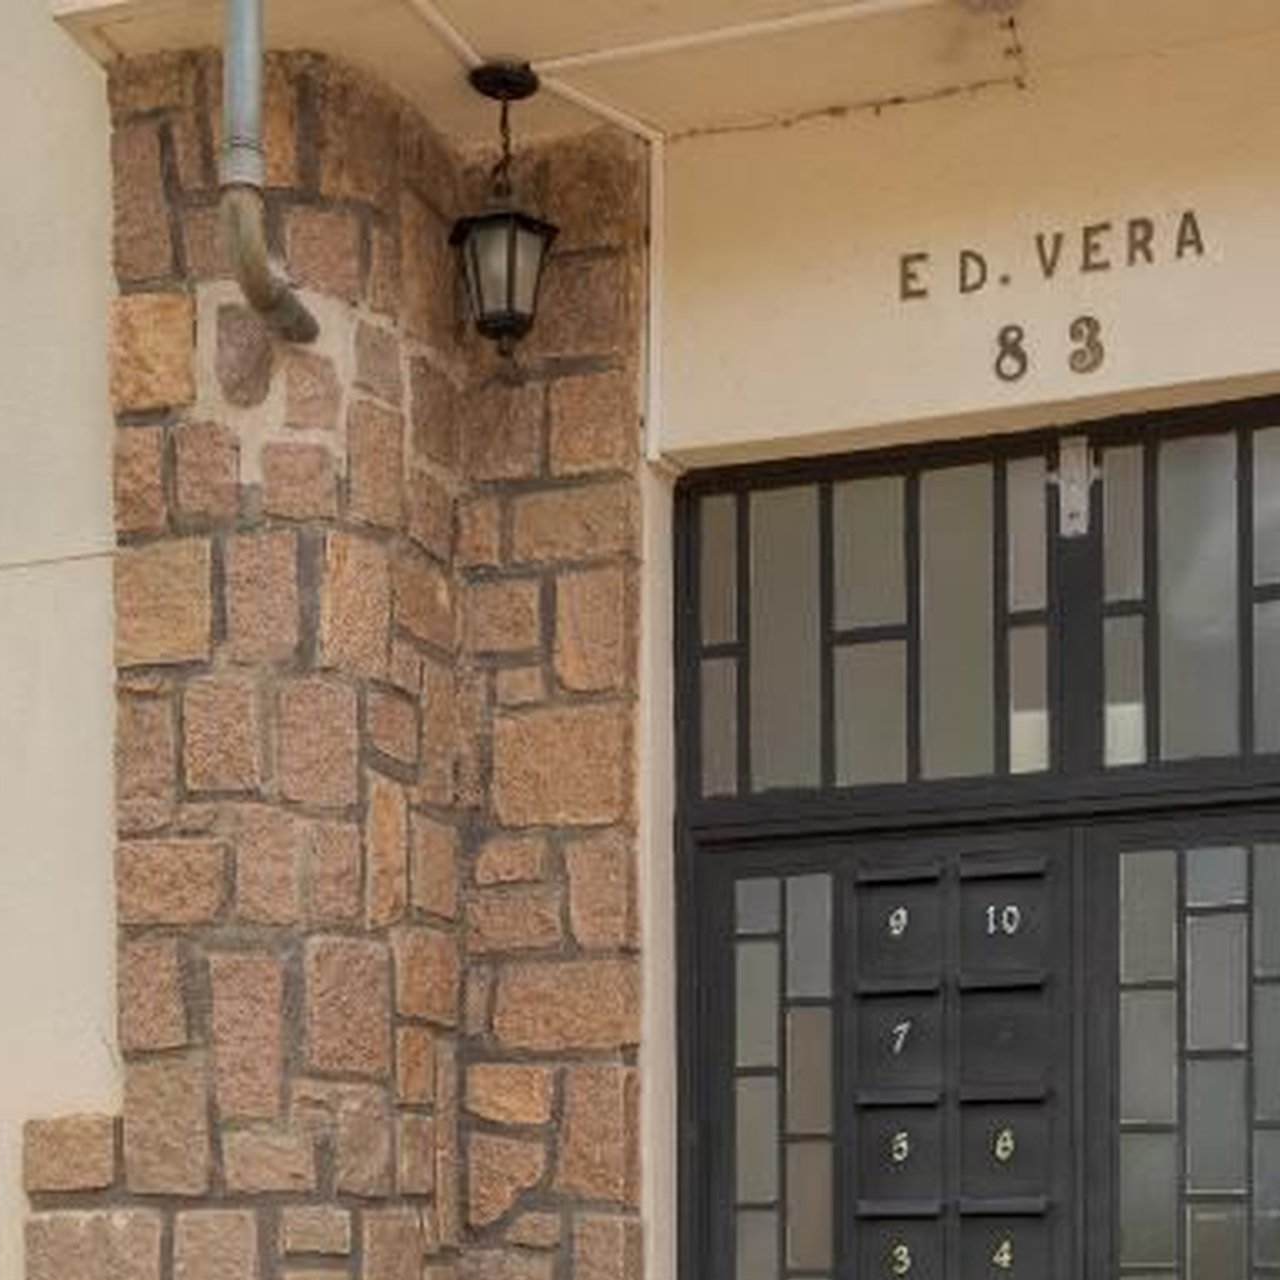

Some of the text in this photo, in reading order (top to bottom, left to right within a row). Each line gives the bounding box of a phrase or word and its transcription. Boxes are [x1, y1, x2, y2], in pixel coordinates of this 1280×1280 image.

[900, 211, 1205, 300] ED. VERA
[995, 316, 1105, 382] 83
[889, 907, 907, 935] 9
[986, 906, 1020, 933] 10
[892, 1020, 911, 1053] 7
[996, 1129, 1014, 1160] 6
[891, 1245, 911, 1274] 3
[993, 1241, 1012, 1267] 4
